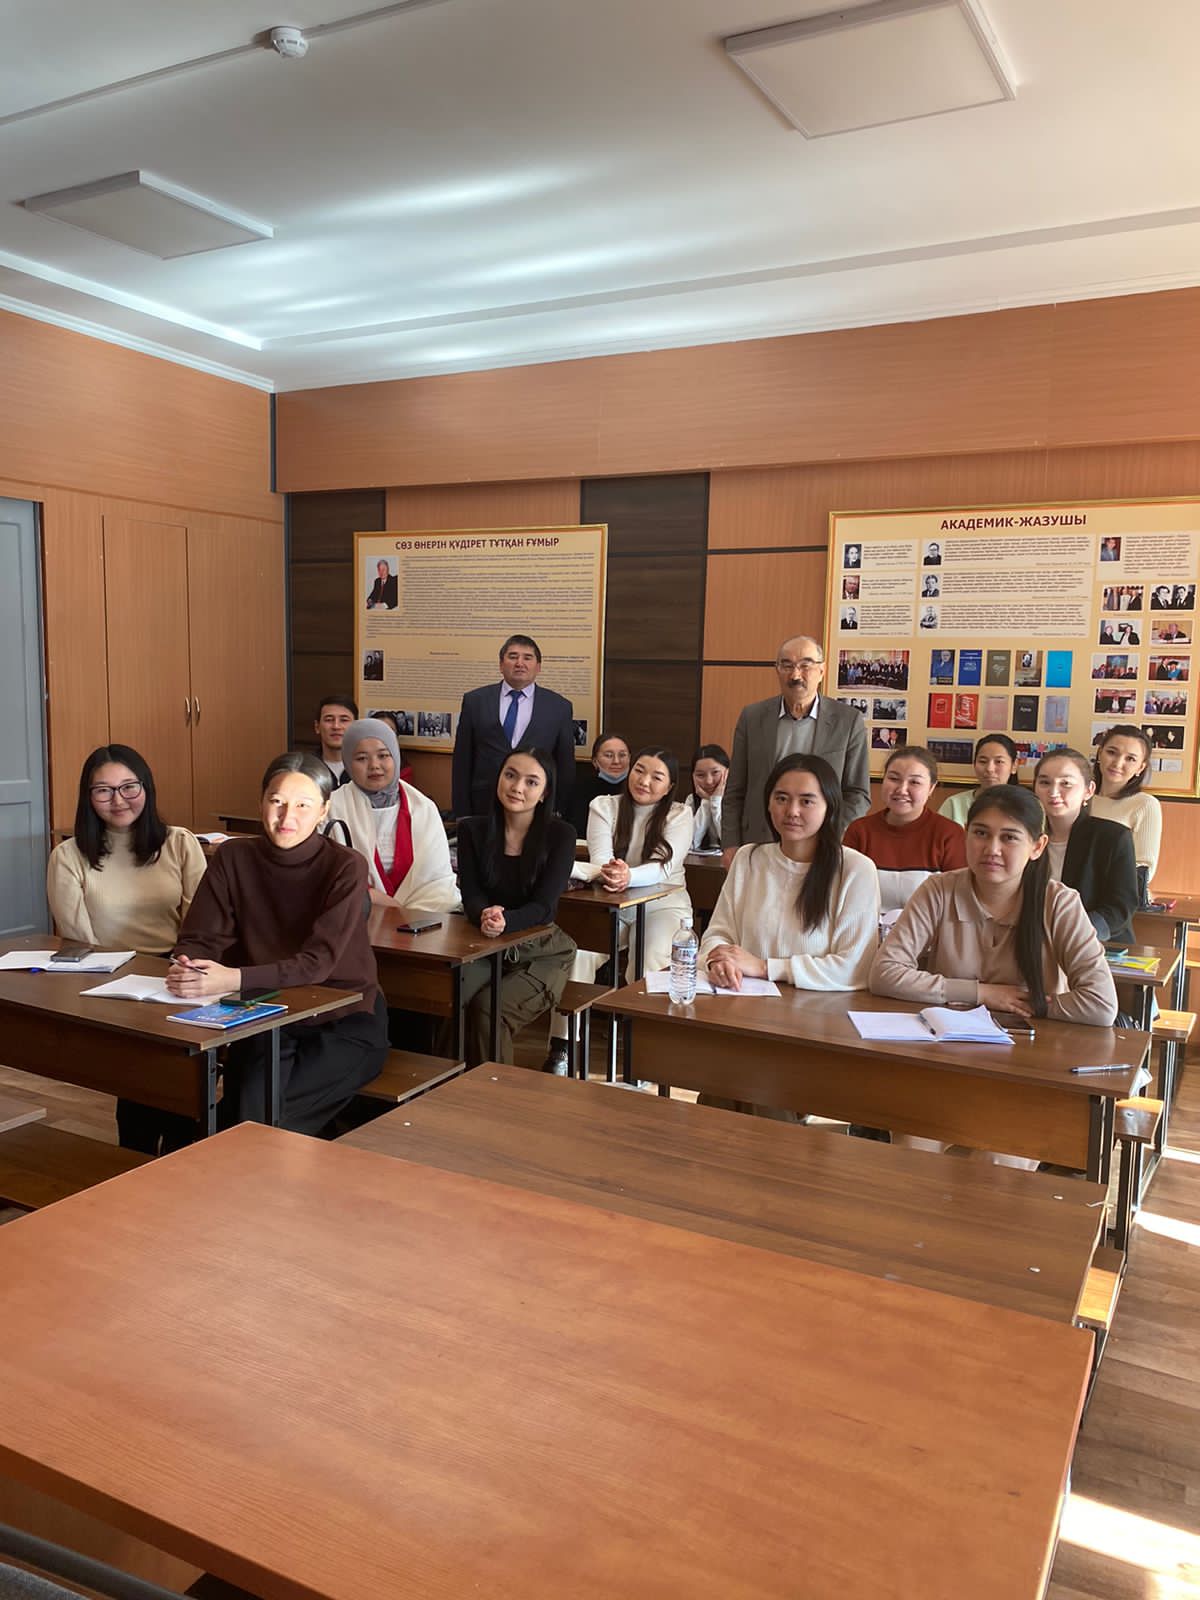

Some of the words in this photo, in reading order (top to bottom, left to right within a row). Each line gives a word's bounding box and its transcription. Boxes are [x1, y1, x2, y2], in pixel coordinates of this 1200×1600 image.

[940, 514, 1086, 531] АКАДЕМИК-ЖАЗУШЫ
[395, 541, 412, 550] СӨЗ
[415, 540, 446, 550] ӨНЕРІН
